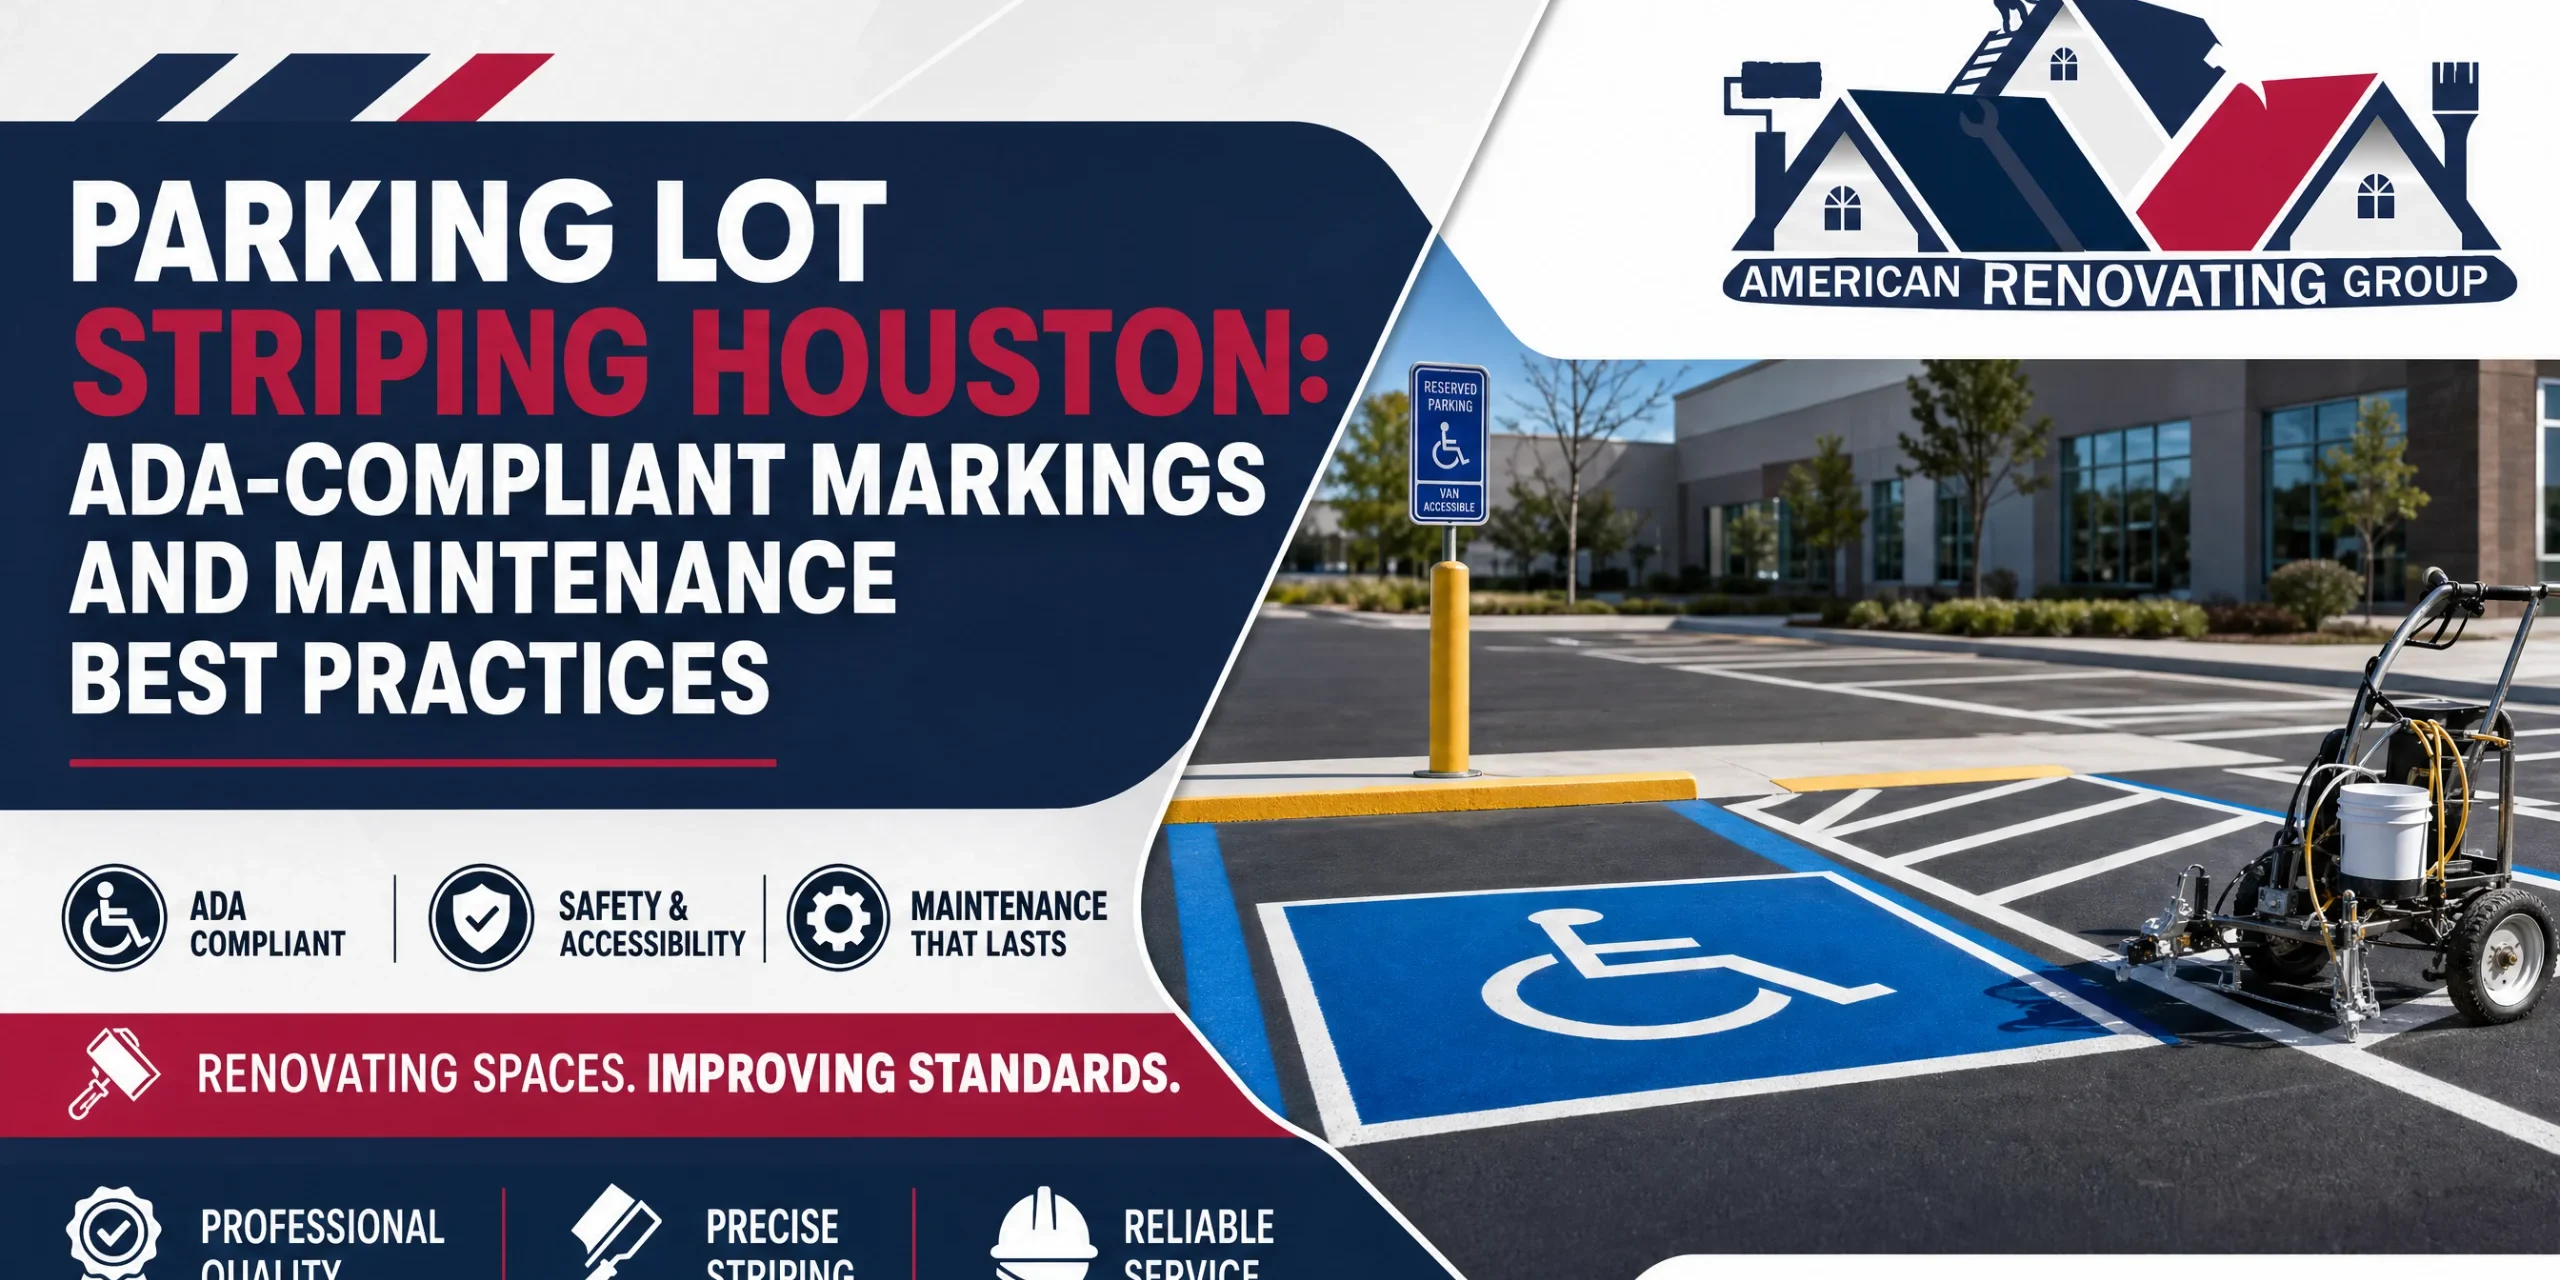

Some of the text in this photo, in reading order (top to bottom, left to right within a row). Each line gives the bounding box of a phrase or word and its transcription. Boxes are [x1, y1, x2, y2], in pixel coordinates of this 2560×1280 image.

[1424, 380, 1477, 395] RESERVED
[1428, 398, 1473, 412] PARKING
[1440, 488, 1459, 499] VAN
[1423, 502, 1475, 512] ACCESSIBLE
